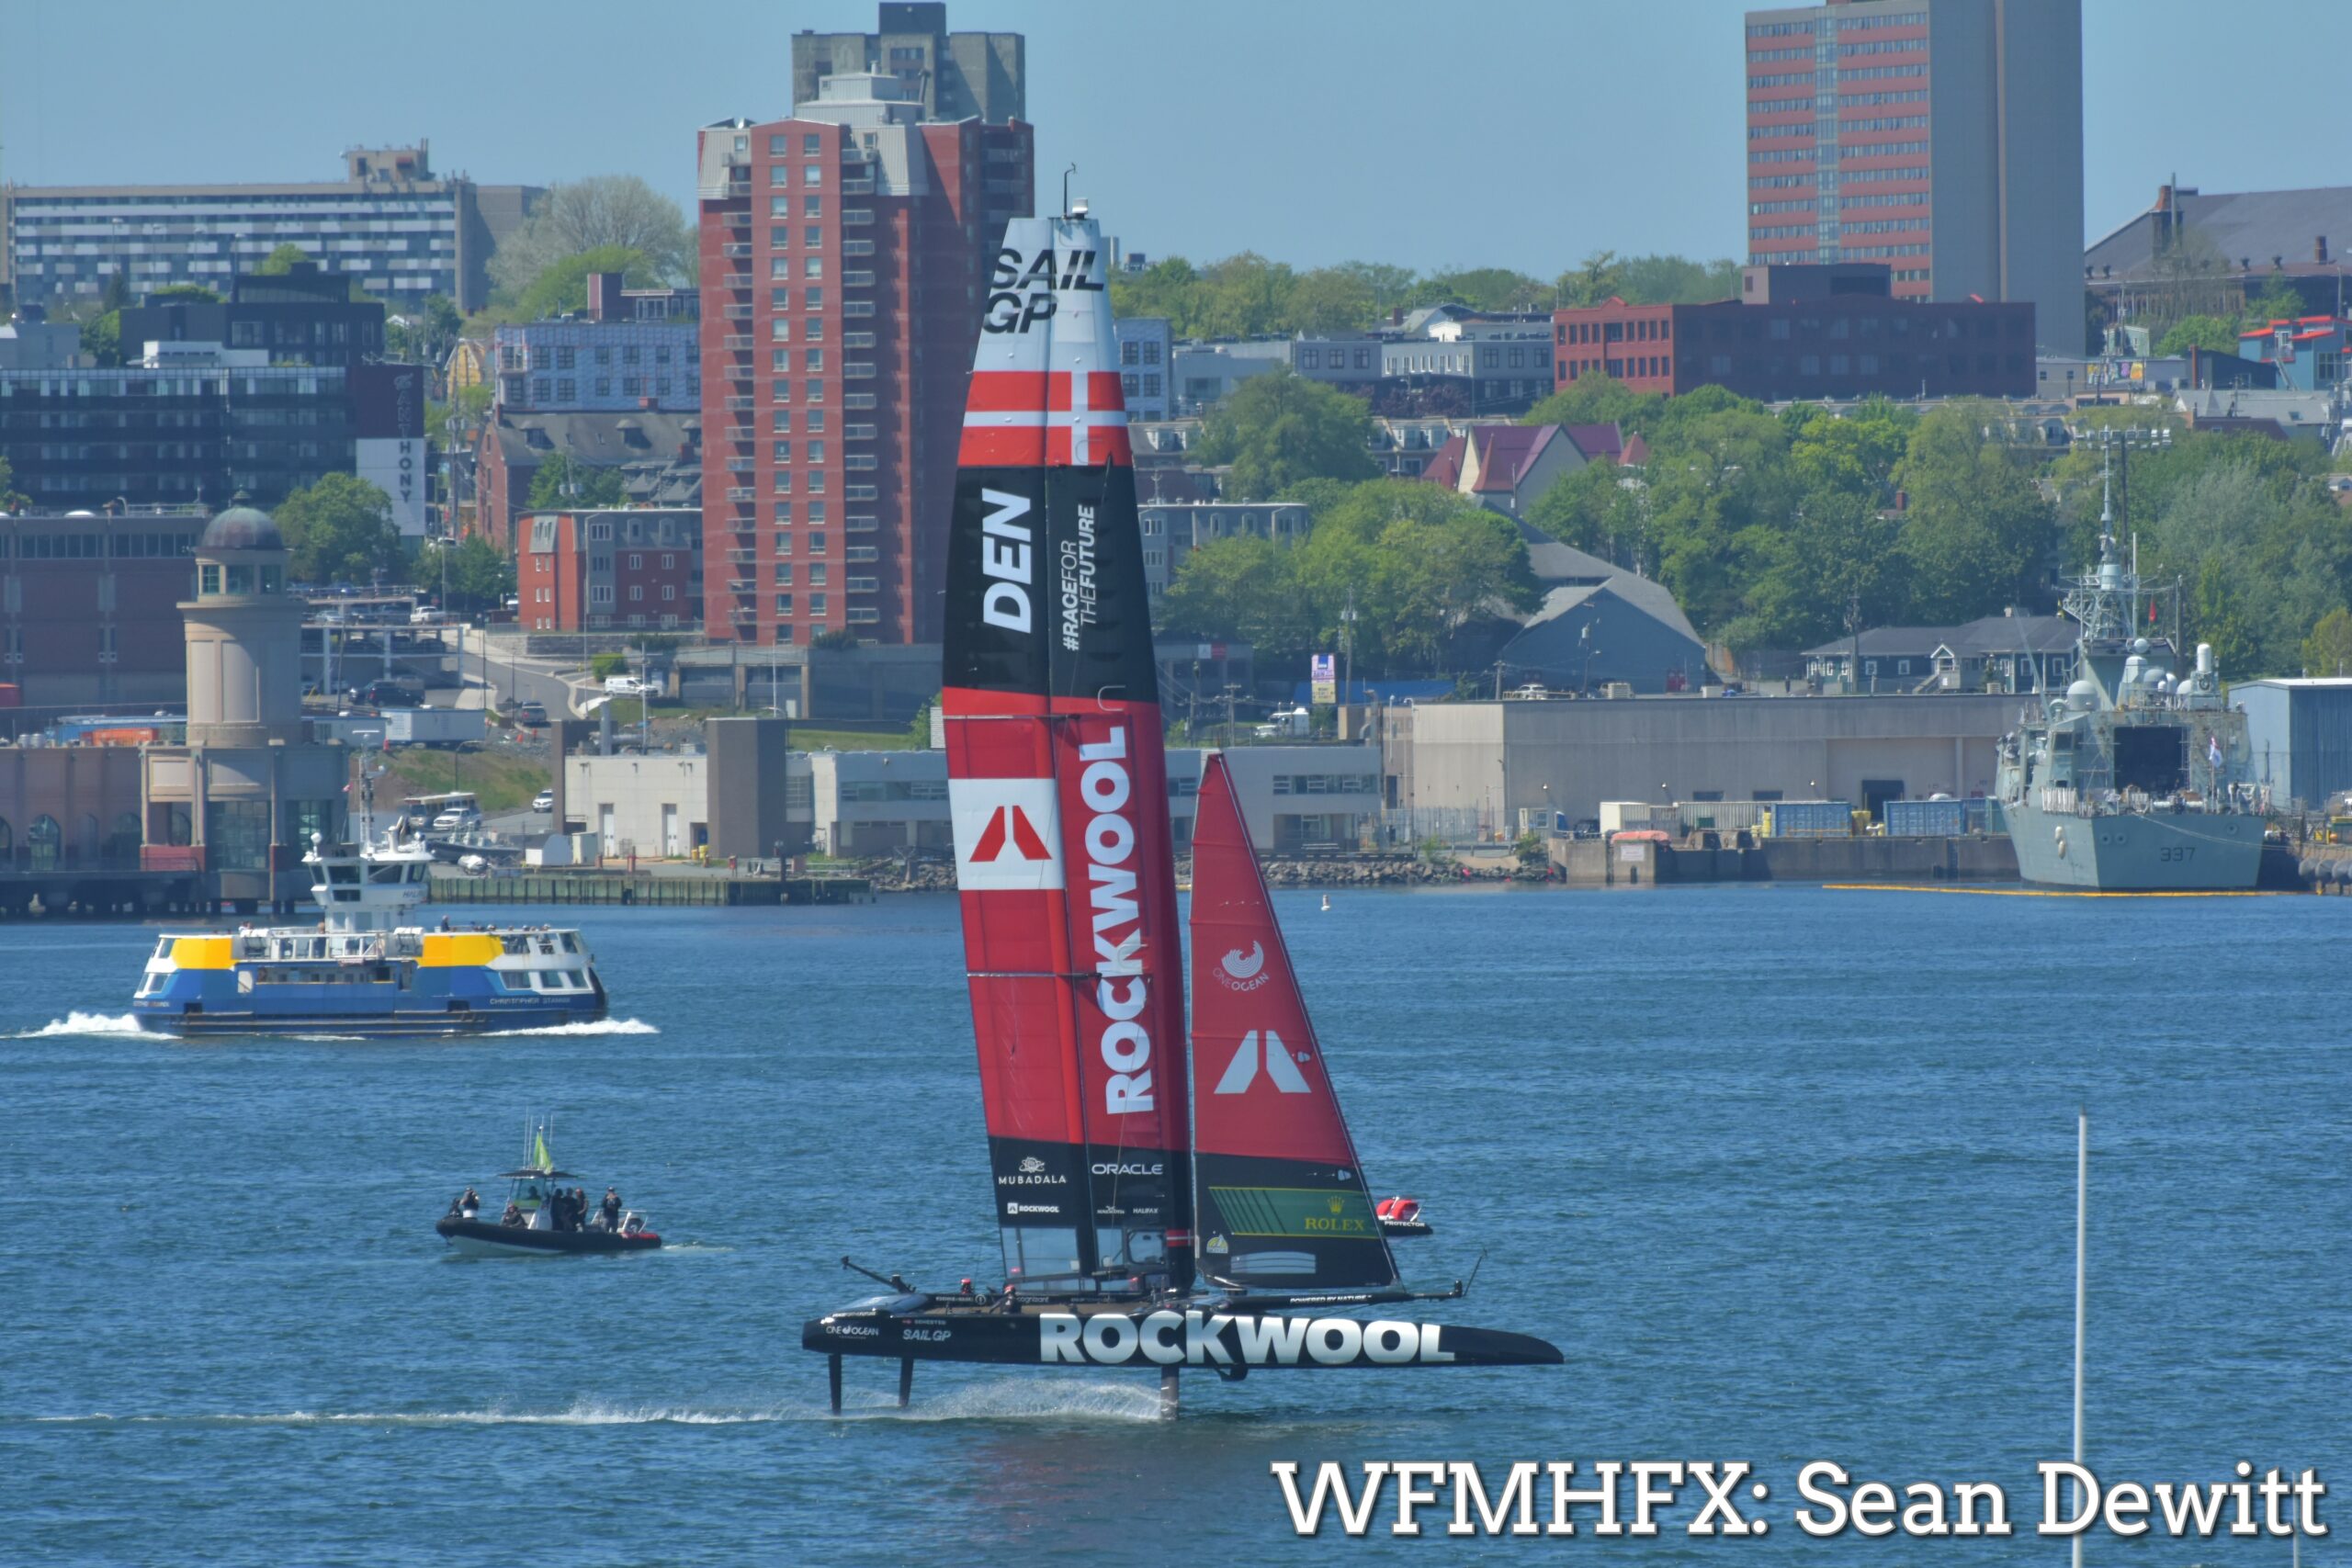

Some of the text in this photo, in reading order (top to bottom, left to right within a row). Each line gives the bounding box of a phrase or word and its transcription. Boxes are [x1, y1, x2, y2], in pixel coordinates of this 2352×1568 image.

[990, 248, 1104, 291] SAIL
[982, 291, 1058, 333] GP
[981, 488, 1032, 634] DEN
[1078, 503, 1097, 626] THEFUTURE
[1061, 540, 1080, 651] #RACEFOR
[2160, 847, 2196, 862] 337
[1079, 726, 1154, 1115] ROCKWOOL
[998, 1175, 1067, 1185] MUBADALA
[1091, 1163, 1164, 1175] ORACLE
[1305, 1217, 1365, 1232] ROLEX
[1040, 1310, 1456, 1365] ROCKWOOL
